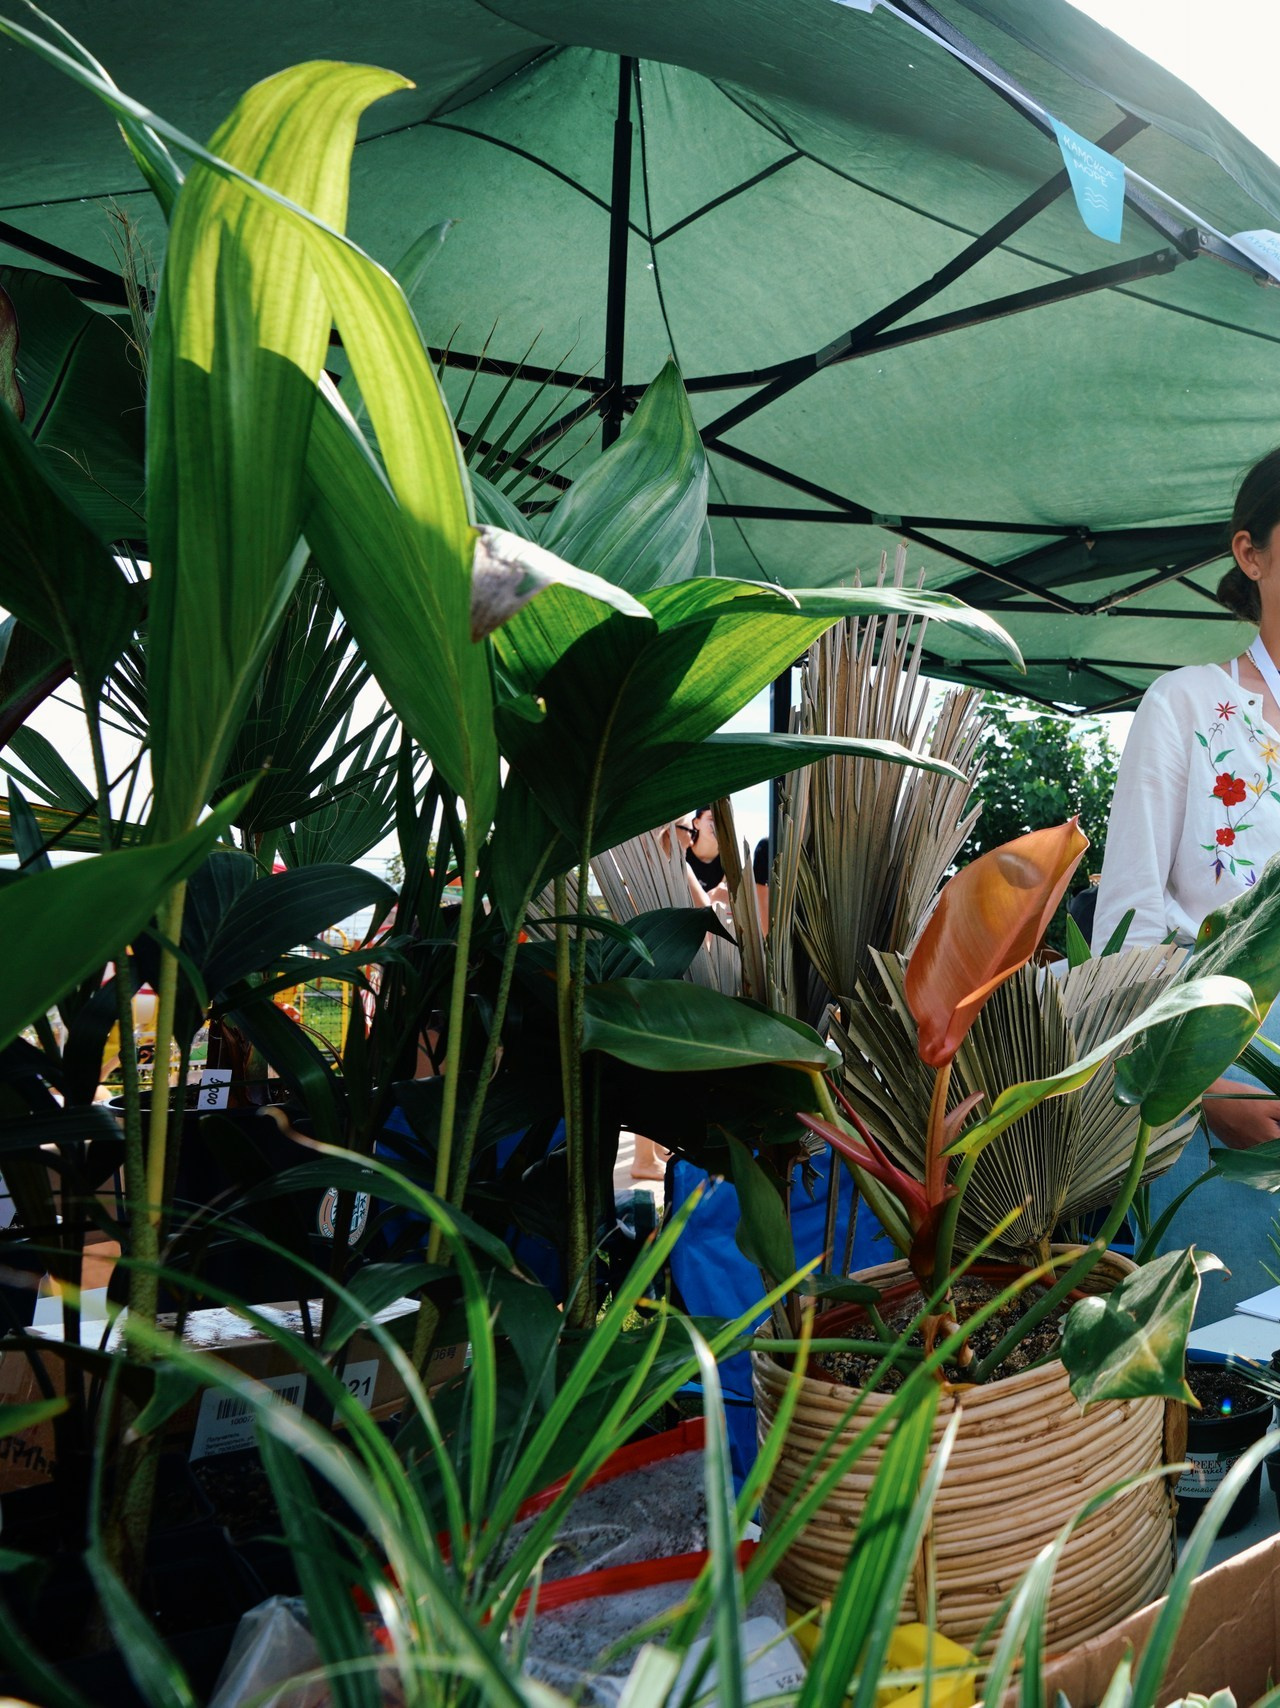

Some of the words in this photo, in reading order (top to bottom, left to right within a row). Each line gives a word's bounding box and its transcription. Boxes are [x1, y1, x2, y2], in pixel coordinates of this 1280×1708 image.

[1063, 134, 1117, 181] КАМСКОЕ
[1073, 160, 1108, 188] МОРЕ
[345, 1376, 371, 1398] 21
